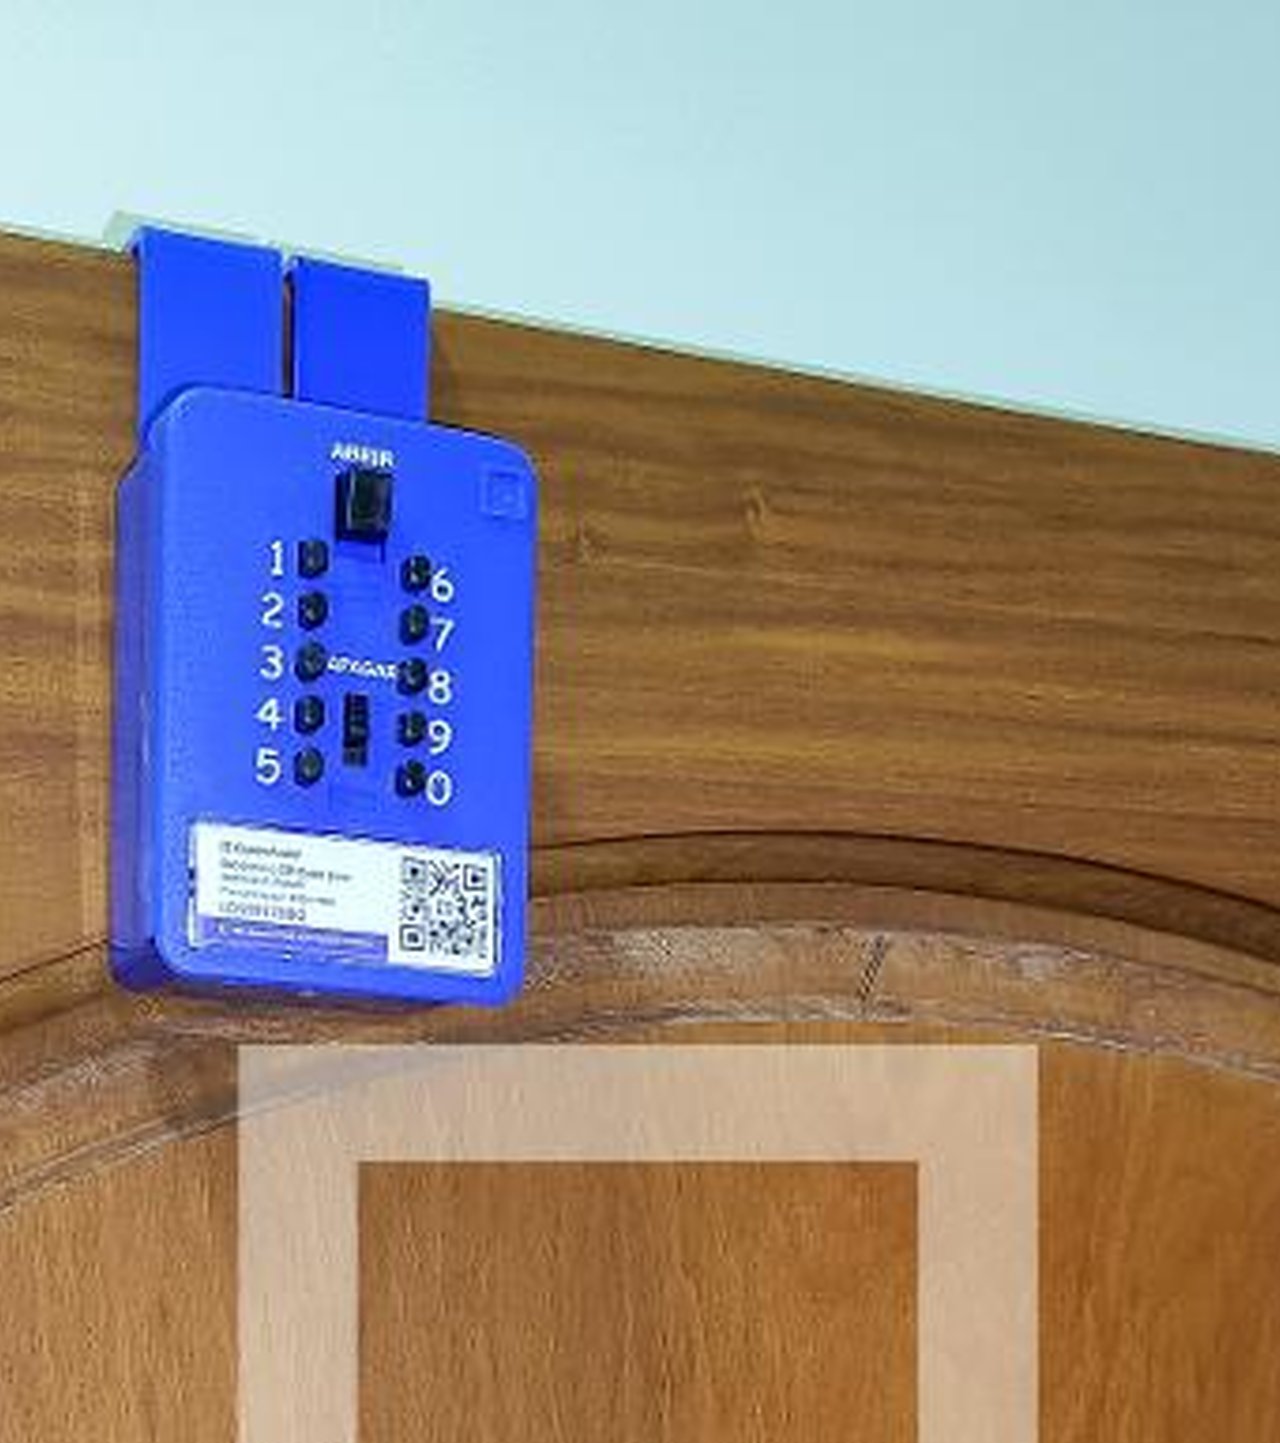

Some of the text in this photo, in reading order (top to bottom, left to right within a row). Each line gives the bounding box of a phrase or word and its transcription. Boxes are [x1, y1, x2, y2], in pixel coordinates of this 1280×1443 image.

[330, 442, 394, 468] ABRIR
[270, 540, 284, 576] 1
[430, 568, 454, 603] 6
[261, 592, 284, 629] 2
[430, 617, 455, 651] 7
[260, 645, 284, 680] 3
[427, 669, 453, 705] 8
[255, 697, 284, 731] 4
[427, 719, 453, 755] 9
[256, 747, 282, 786] 5
[425, 769, 453, 807] 0
